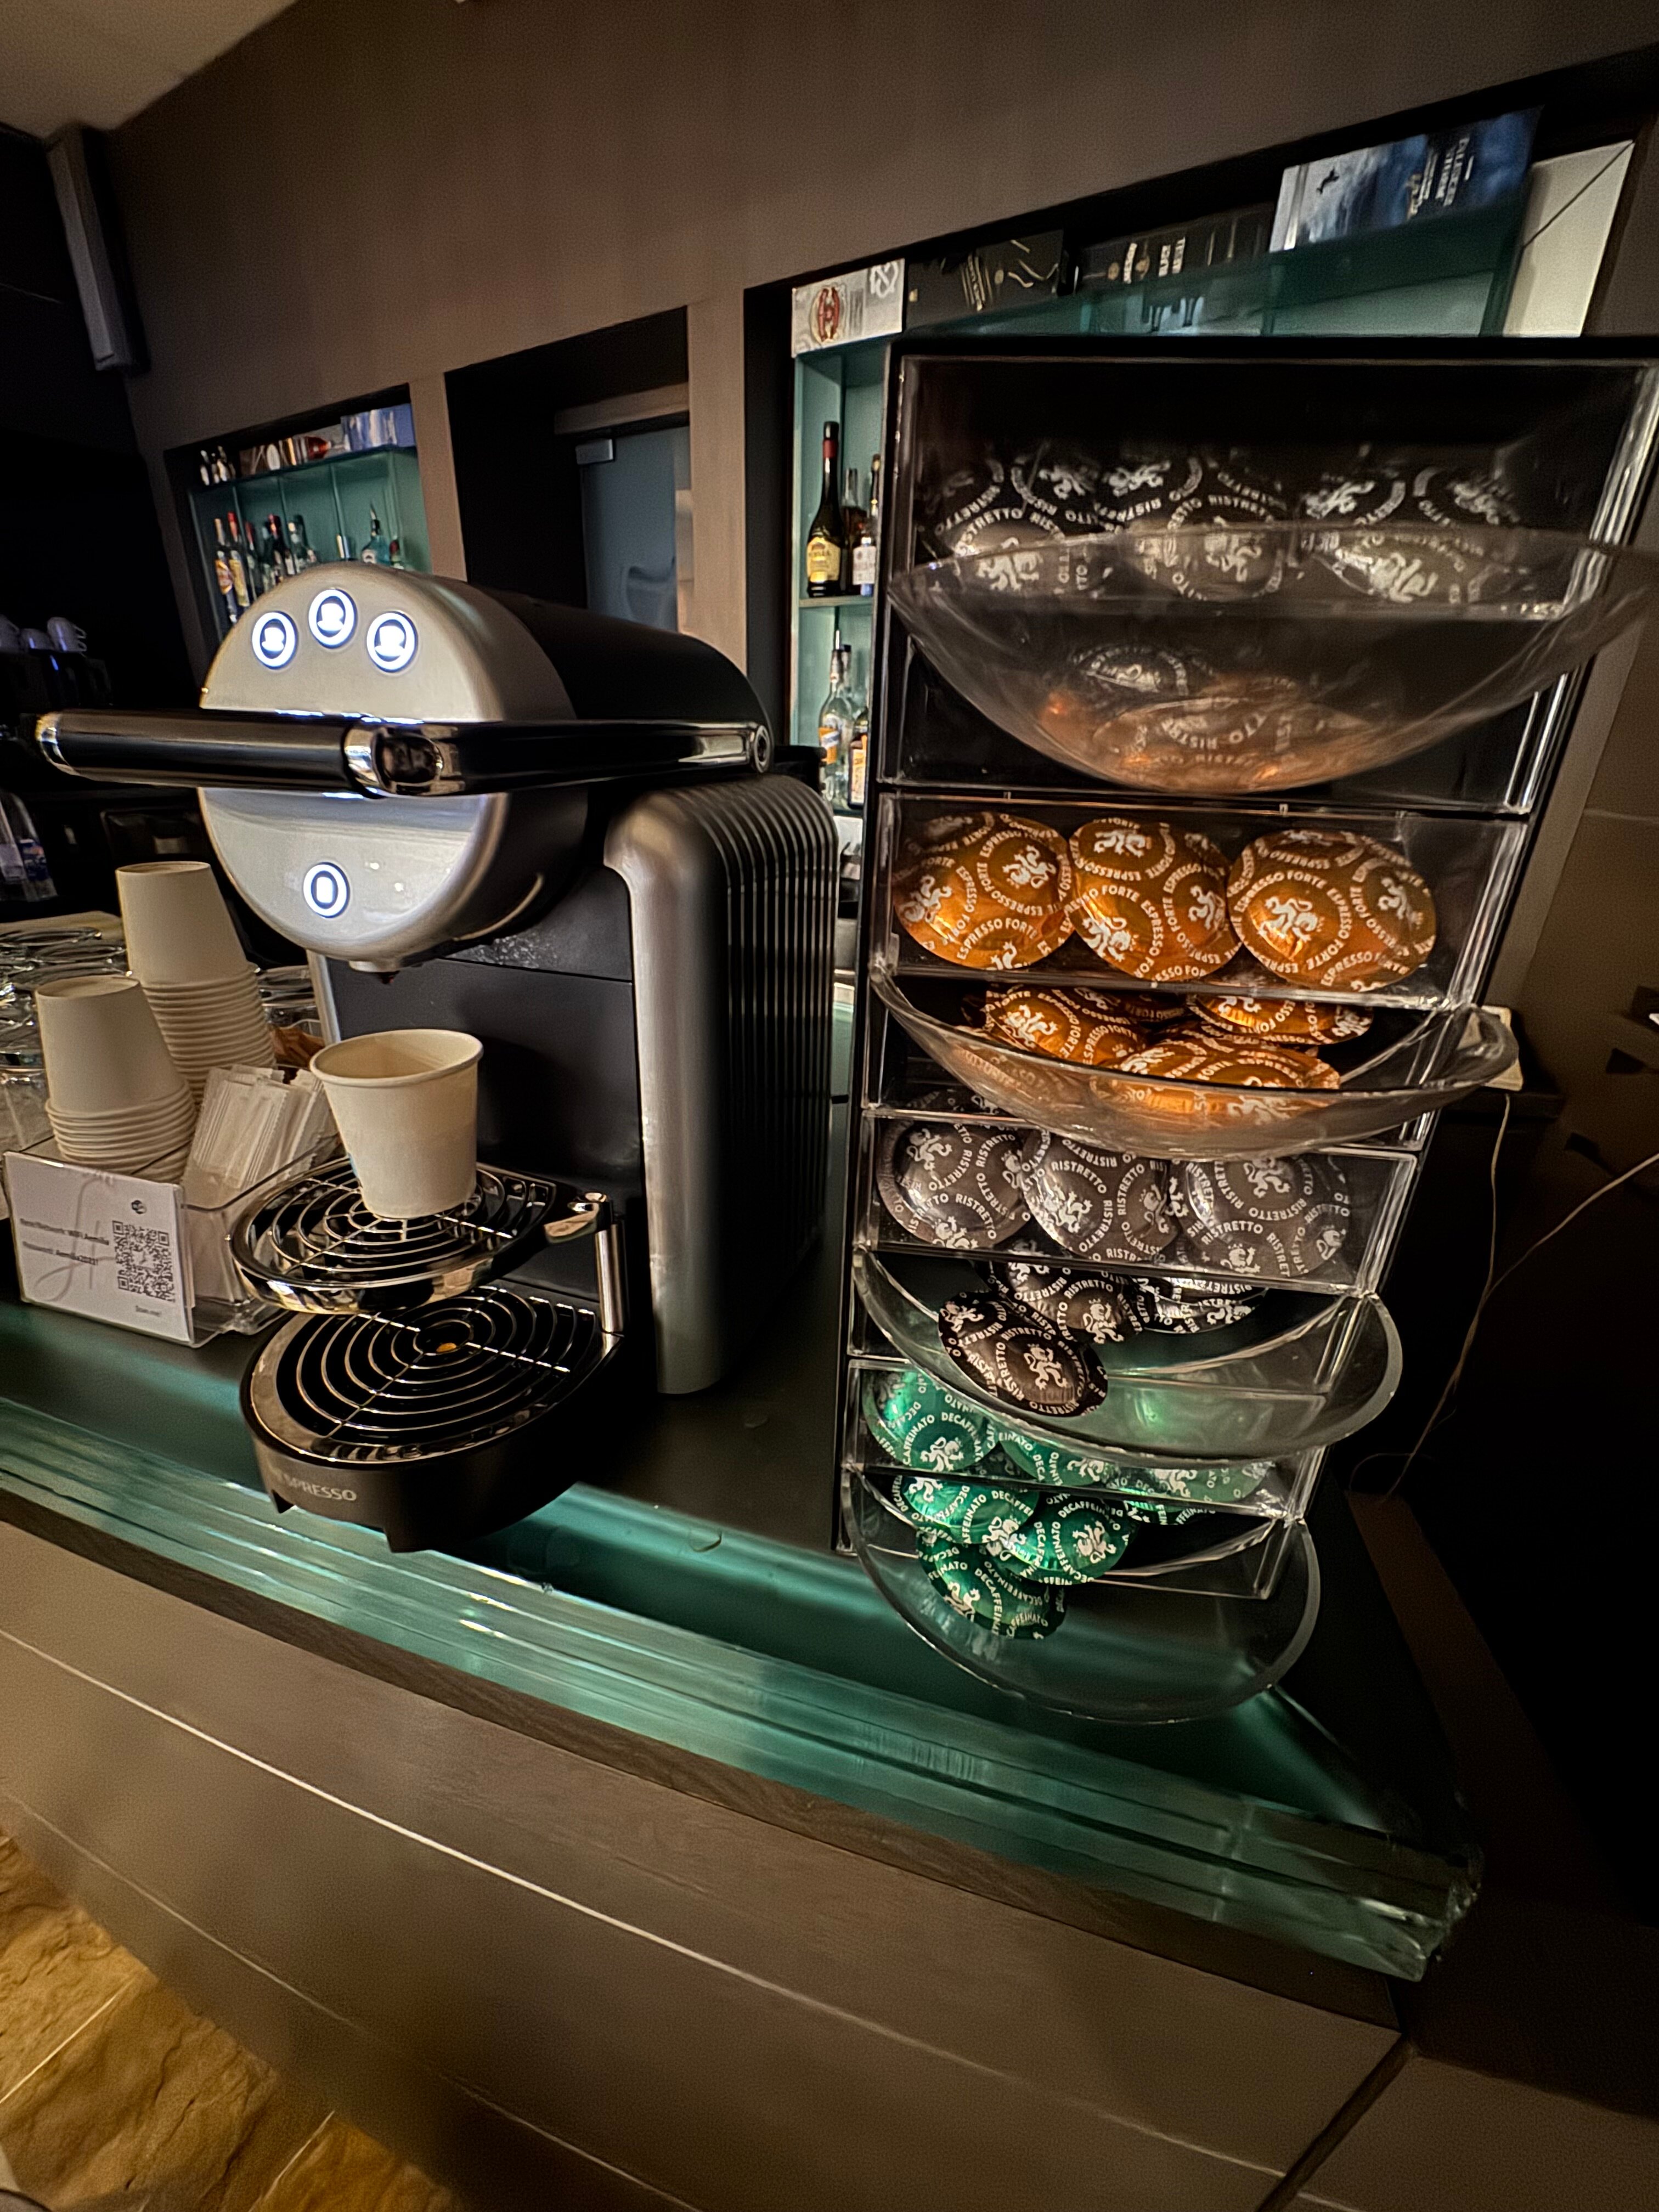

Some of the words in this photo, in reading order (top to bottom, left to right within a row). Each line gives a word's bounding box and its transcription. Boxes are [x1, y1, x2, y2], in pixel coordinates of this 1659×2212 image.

[956, 866, 978, 913] ESPRESSO
[1085, 863, 1142, 881] ESPRESSO
[1286, 870, 1328, 890] FORTE
[991, 890, 1043, 916] ESPRESSO
[1102, 885, 1140, 902] FORTE
[1234, 871, 1285, 913] ESPRESSO
[1141, 899, 1164, 956] ESPRESSO
[1162, 897, 1181, 932] FORTE
[1327, 888, 1353, 939] ESPRESSO
[957, 918, 1003, 960] ESPRESSO
[1005, 918, 1038, 939] FORTE
[1307, 939, 1345, 970] FORTE
[1133, 956, 1155, 979] FOR
[1155, 965, 1183, 982] ESSO
[1321, 951, 1373, 987] ESPRESSO
[1037, 993, 1080, 1025] ESPRESSO
[1059, 1026, 1081, 1058] FORTE
[1083, 1024, 1109, 1065] ESPRESSO
[975, 1134, 1015, 1167] RISTRETTO
[1062, 1139, 1118, 1167] RISTRETTO
[929, 1149, 973, 1191] RISTRETTO
[1051, 1160, 1107, 1194] RISTRETTO
[1079, 1200, 1113, 1252] RISTRETTO
[1117, 1164, 1145, 1215] RISTRETTO
[955, 1193, 997, 1239] RISTRETTO
[1249, 1198, 1307, 1221] RISTRETTO
[1106, 1248, 1142, 1261] RISTR
[1201, 1220, 1263, 1245] RISTRETTO
[1266, 1232, 1290, 1277] RISTRET
[1014, 1277, 1068, 1302] RISTRETTO
[1064, 1279, 1114, 1299] RISTRETTO
[1001, 1328, 1052, 1340] RISTRETTO
[996, 1342, 1025, 1401] RISTRETTO
[1049, 1452, 1063, 1486] EINATO
[962, 1494, 986, 1544] AFFEINATO
[992, 1490, 1034, 1517] DECAFFEI
[974, 1568, 1003, 1636] DECAFFEINA
